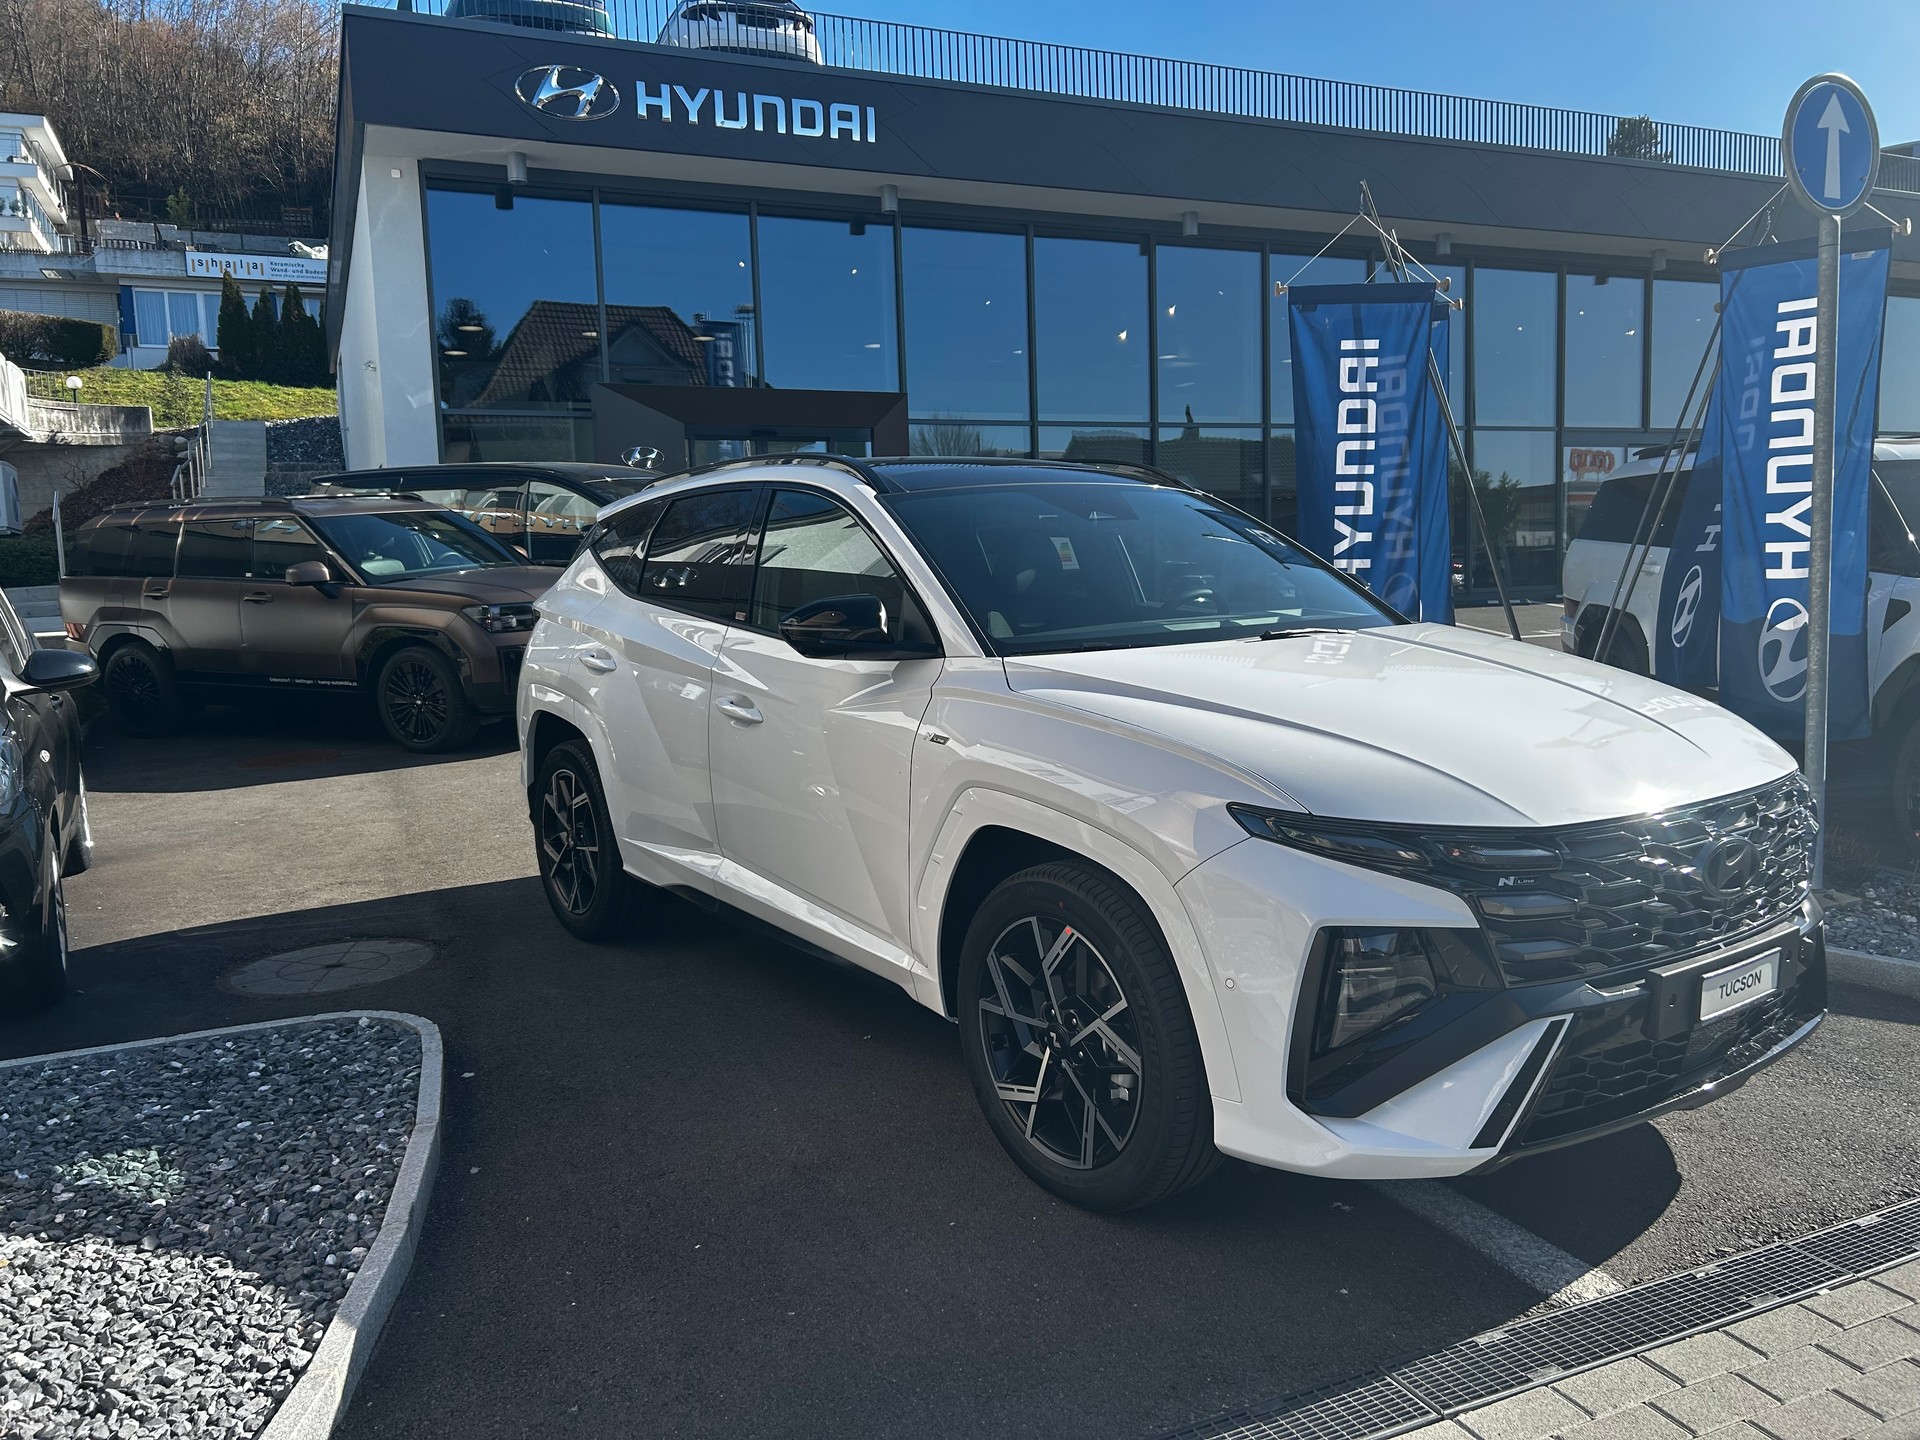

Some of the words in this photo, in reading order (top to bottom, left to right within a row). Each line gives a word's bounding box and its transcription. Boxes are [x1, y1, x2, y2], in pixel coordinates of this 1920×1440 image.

[635, 80, 876, 143] HYUNDAI
[1498, 876, 1516, 887] N
[1719, 969, 1762, 999] TUCSON
